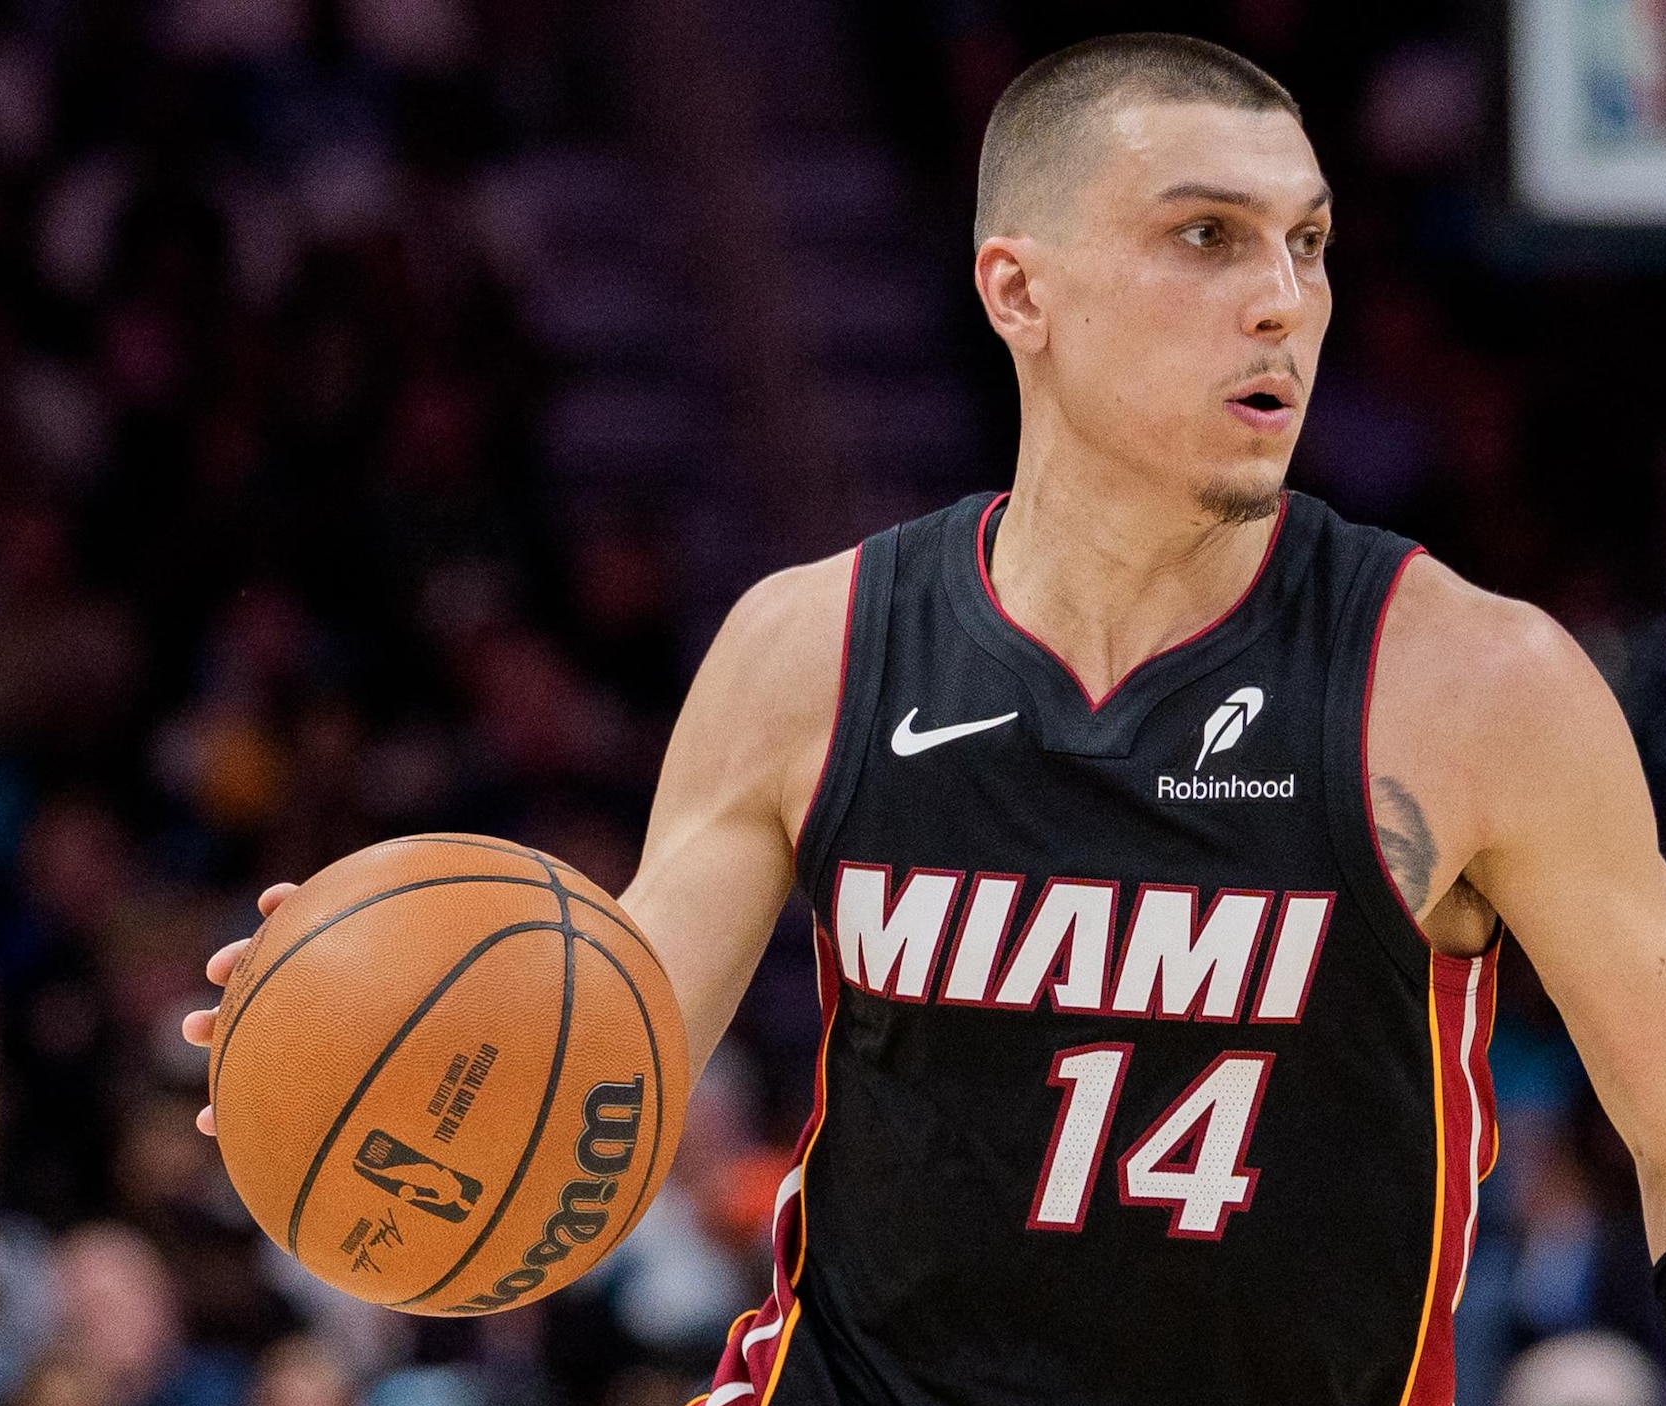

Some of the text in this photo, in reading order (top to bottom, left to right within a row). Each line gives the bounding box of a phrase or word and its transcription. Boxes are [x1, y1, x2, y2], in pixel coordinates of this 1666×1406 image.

[1157, 774, 1295, 799] Robinhood
[834, 860, 1337, 1025] MIAMI
[426, 1053, 469, 1117] GENUINE LEATHER
[433, 1043, 499, 1143] OFFICIAL GAME BALL
[365, 1135, 392, 1165] NBA
[1026, 1042, 1276, 1241] 14
[441, 1073, 645, 1312] Wilson
